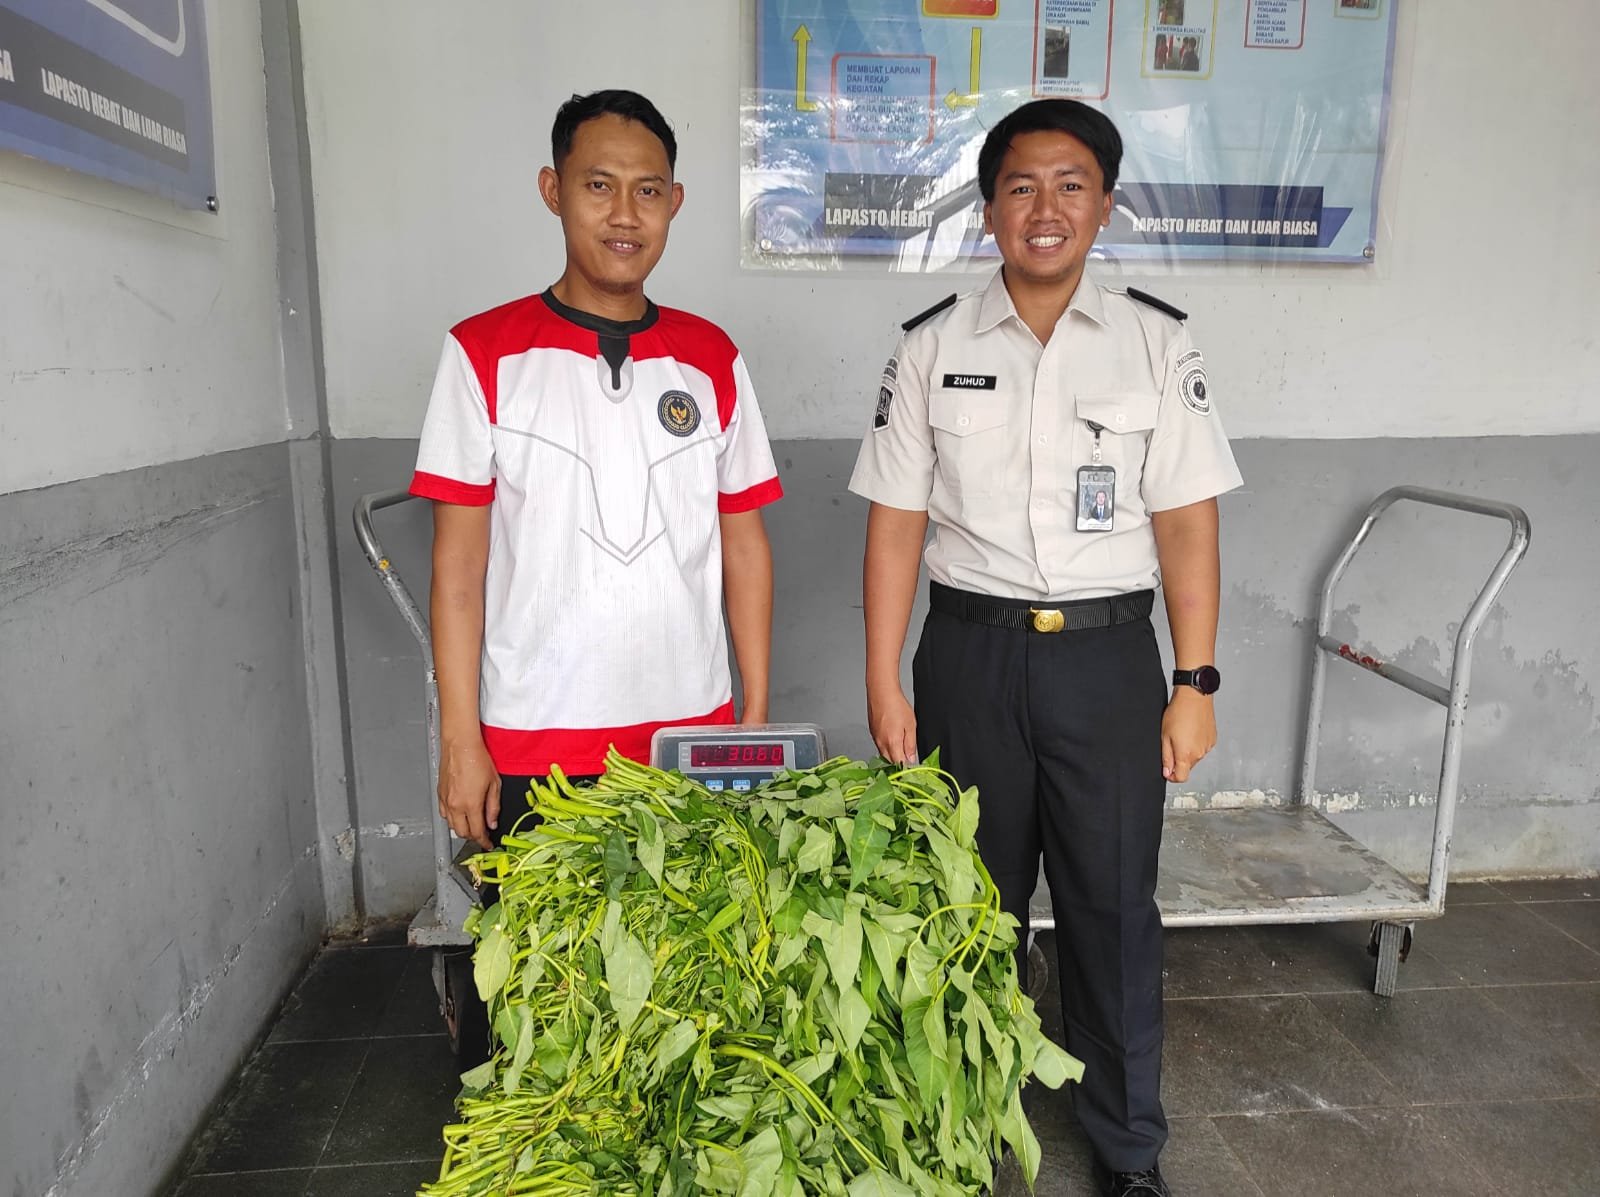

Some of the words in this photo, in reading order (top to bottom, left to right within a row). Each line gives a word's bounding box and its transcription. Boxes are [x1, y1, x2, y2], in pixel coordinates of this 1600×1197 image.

[846, 64, 884, 73] MEMBUAT
[885, 65, 921, 75] LAPORAN
[846, 74, 863, 83] DAN
[864, 75, 890, 84] REKAP
[846, 84, 884, 94] KEGIATAN
[41, 68, 91, 112] LAPASTO
[90, 91, 121, 126] HEBAT
[121, 105, 142, 136] DAN
[141, 115, 163, 145] LUAR
[163, 126, 188, 155] BIASA
[825, 207, 888, 227] LAPASTO
[890, 209, 935, 228] HEBAT
[1132, 217, 1182, 233] LAPASTO
[1186, 218, 1223, 234] HEBAT
[1225, 219, 1249, 235] DAN
[1251, 219, 1281, 235] LUAR
[1282, 220, 1318, 236] BIASA
[953, 376, 986, 386] ZUHUD
